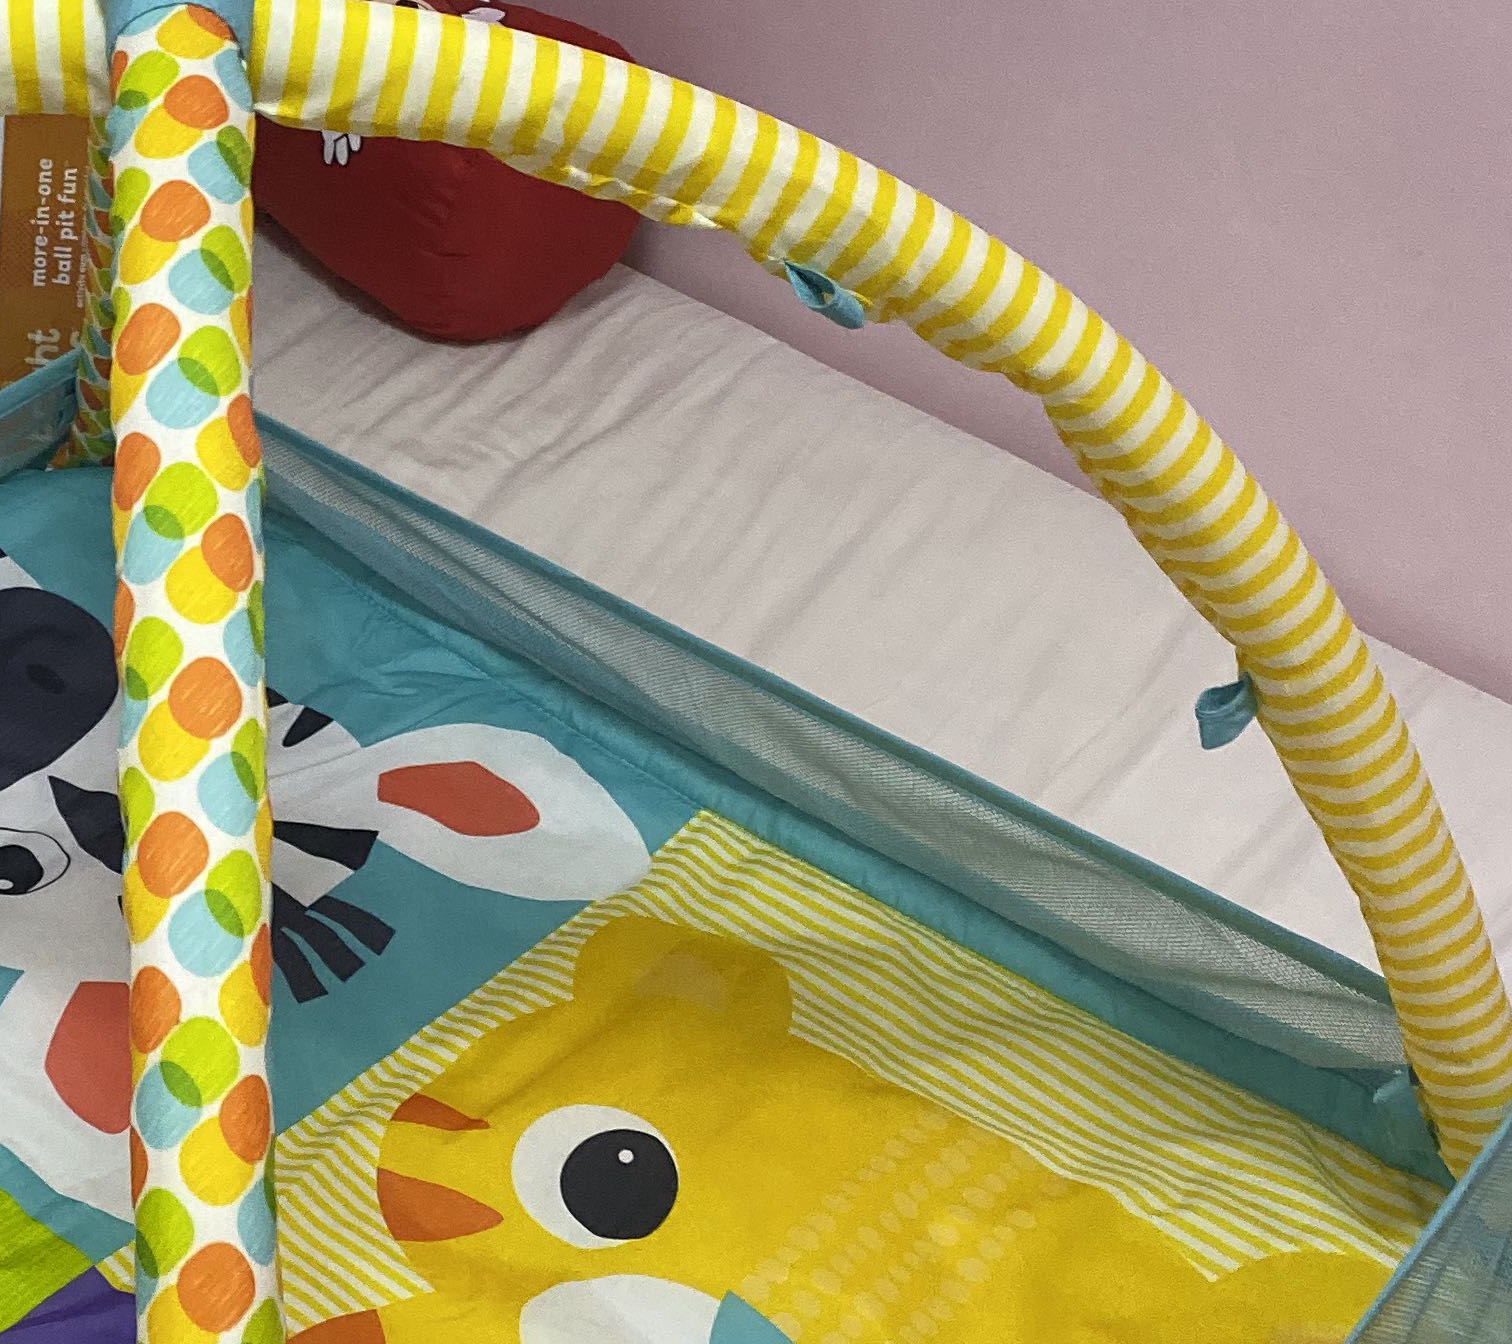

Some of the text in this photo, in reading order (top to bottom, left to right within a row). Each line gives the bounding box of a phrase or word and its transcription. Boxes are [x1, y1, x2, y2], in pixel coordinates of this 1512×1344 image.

[29, 158, 54, 287] more-in-one
[51, 168, 78, 285] ball pit fun
